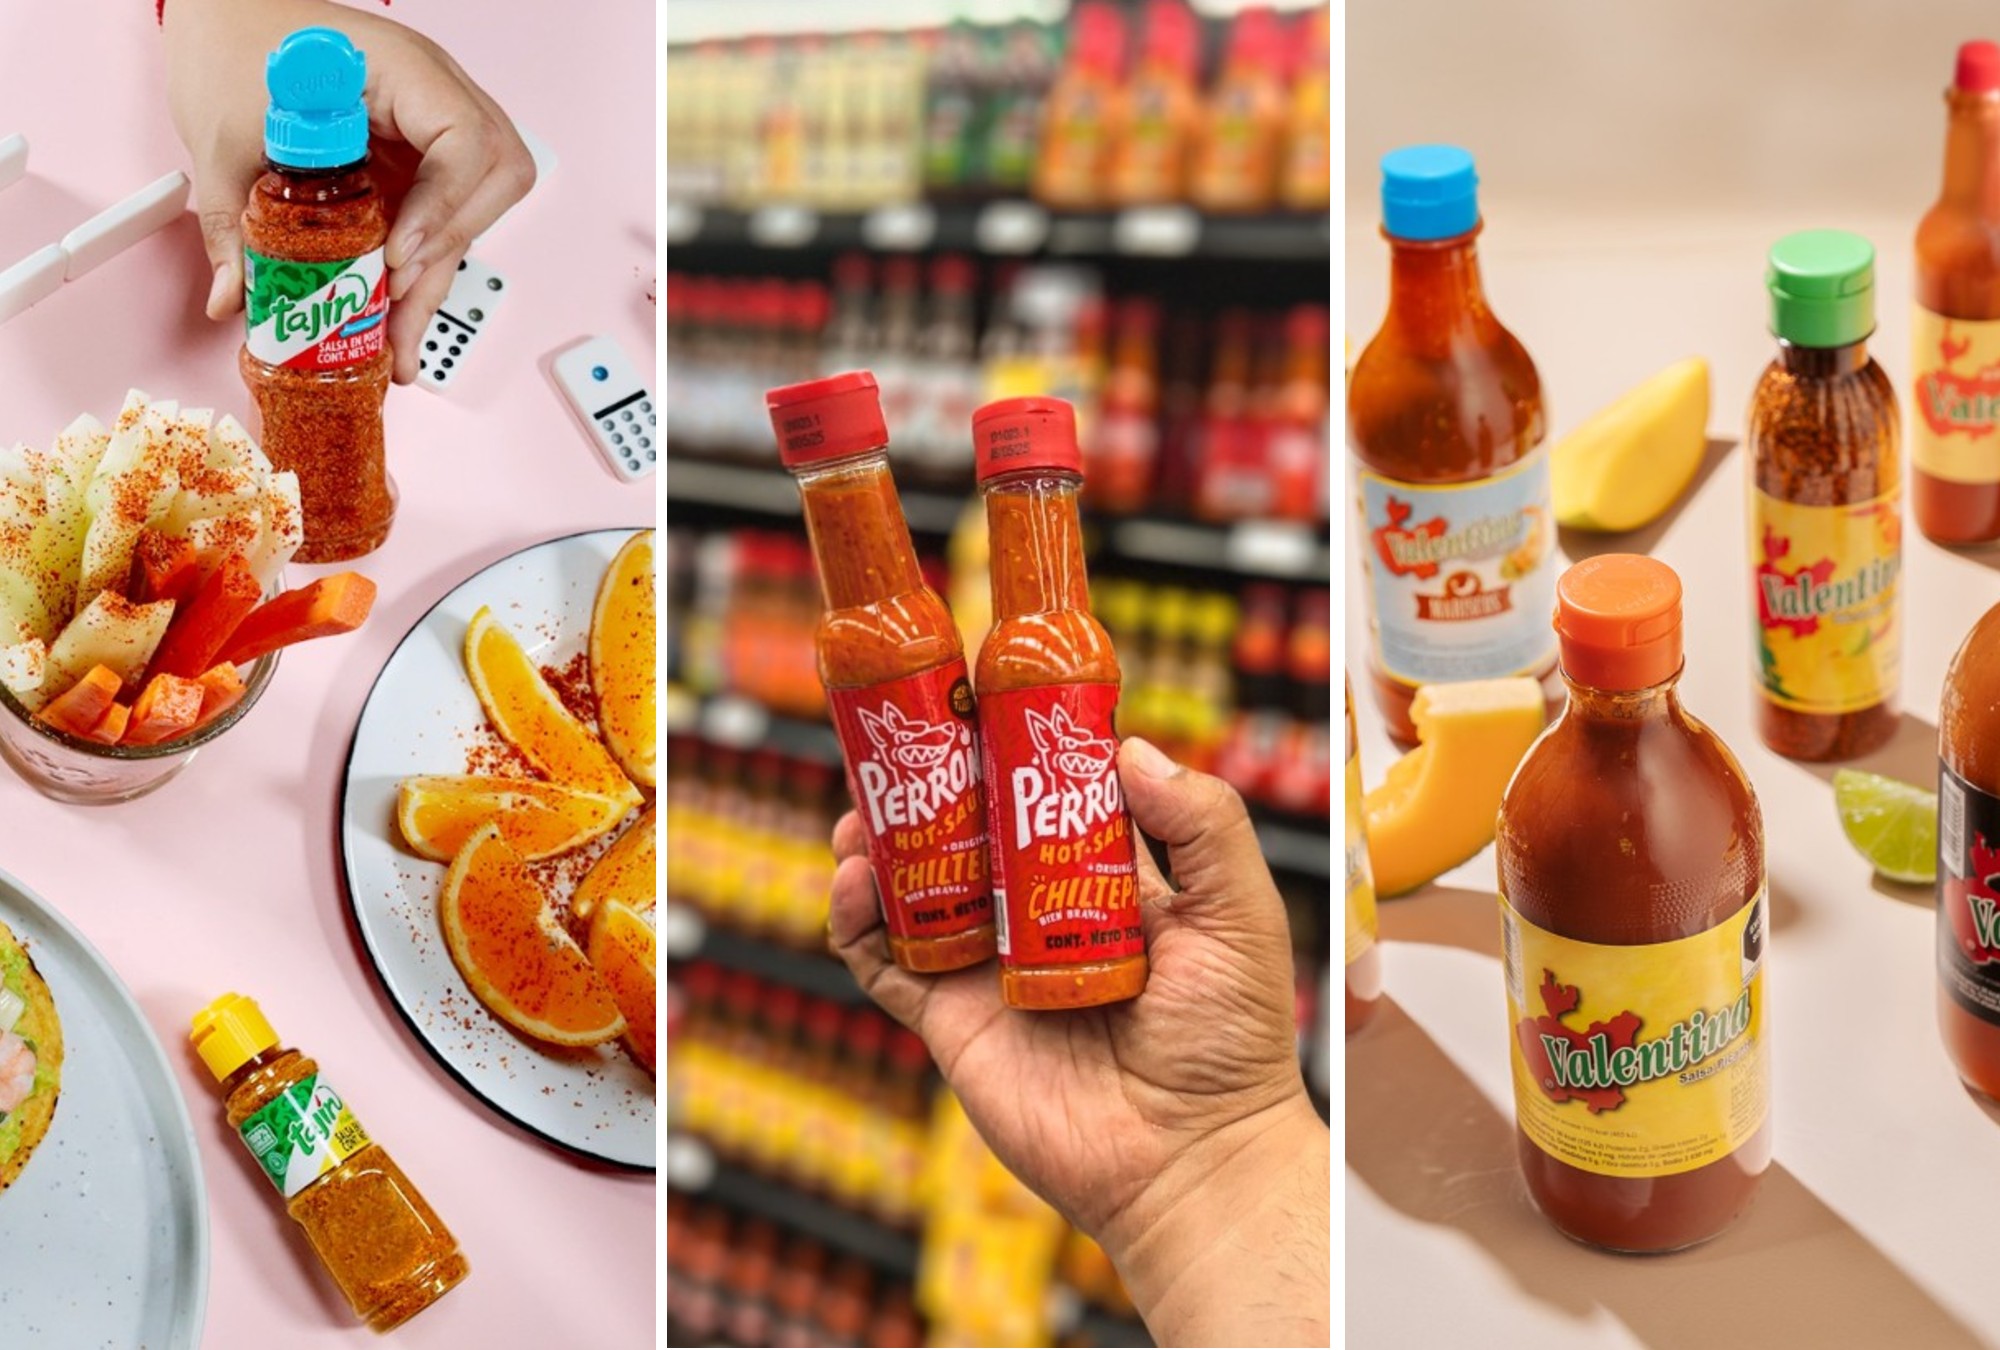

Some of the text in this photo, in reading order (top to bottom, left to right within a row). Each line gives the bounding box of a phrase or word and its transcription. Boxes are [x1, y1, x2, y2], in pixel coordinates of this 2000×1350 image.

[319, 340, 349, 353] SALSA
[317, 351, 346, 363] CONT.
[1012, 767, 1123, 850] PERRO
[904, 884, 961, 905] BIEN BRAVA
[1038, 907, 1101, 927] BIEN BRAVA
[1046, 933, 1086, 949] CONT.
[1090, 929, 1121, 947] NETO
[1541, 989, 1750, 1087] Valentina
[1679, 1066, 1713, 1084] Salsa
